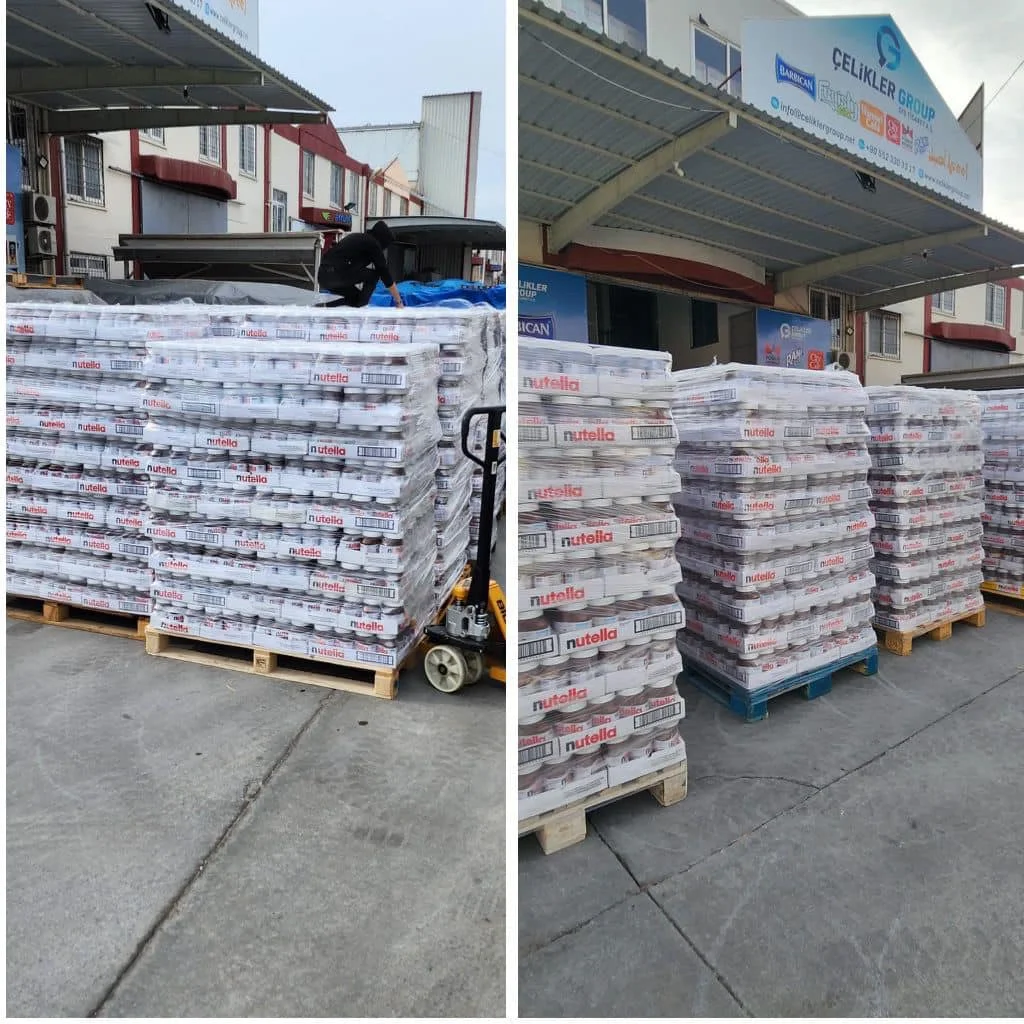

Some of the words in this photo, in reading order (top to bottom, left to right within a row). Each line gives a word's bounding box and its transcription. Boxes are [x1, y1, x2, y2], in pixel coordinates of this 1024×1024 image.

[779, 64, 814, 92] BARBICAN
[898, 88, 936, 122] GROUP
[73, 360, 101, 369] nutella
[314, 373, 348, 383] nutella
[523, 375, 580, 391] nutella
[143, 398, 172, 409] nutella
[39, 420, 65, 430] nutella
[78, 422, 106, 433] nutella
[564, 427, 615, 441] nutella
[744, 428, 775, 438] nutella
[207, 437, 238, 448] nutella
[311, 445, 346, 456] nutella
[112, 457, 140, 468] nutella
[146, 465, 177, 475] nutella
[753, 466, 782, 475] nutella
[236, 474, 267, 484] nutella
[79, 483, 107, 493] nutella
[528, 486, 583, 500] nutella
[711, 501, 735, 511] nutella
[308, 514, 343, 525] nutella
[146, 527, 176, 538] nutella
[561, 530, 613, 547] nutella
[83, 540, 110, 550] nutella
[235, 540, 266, 550] nutella
[289, 546, 321, 558] nutella
[820, 556, 844, 568] nutella
[746, 573, 776, 584] nutella
[312, 581, 345, 593] nutella
[154, 590, 184, 601] nutella
[530, 587, 585, 606] nutella
[350, 620, 384, 632] nutella
[566, 628, 618, 649] nutella
[311, 646, 345, 658] nutella
[532, 688, 588, 712] nutella
[566, 727, 617, 751] nutella
